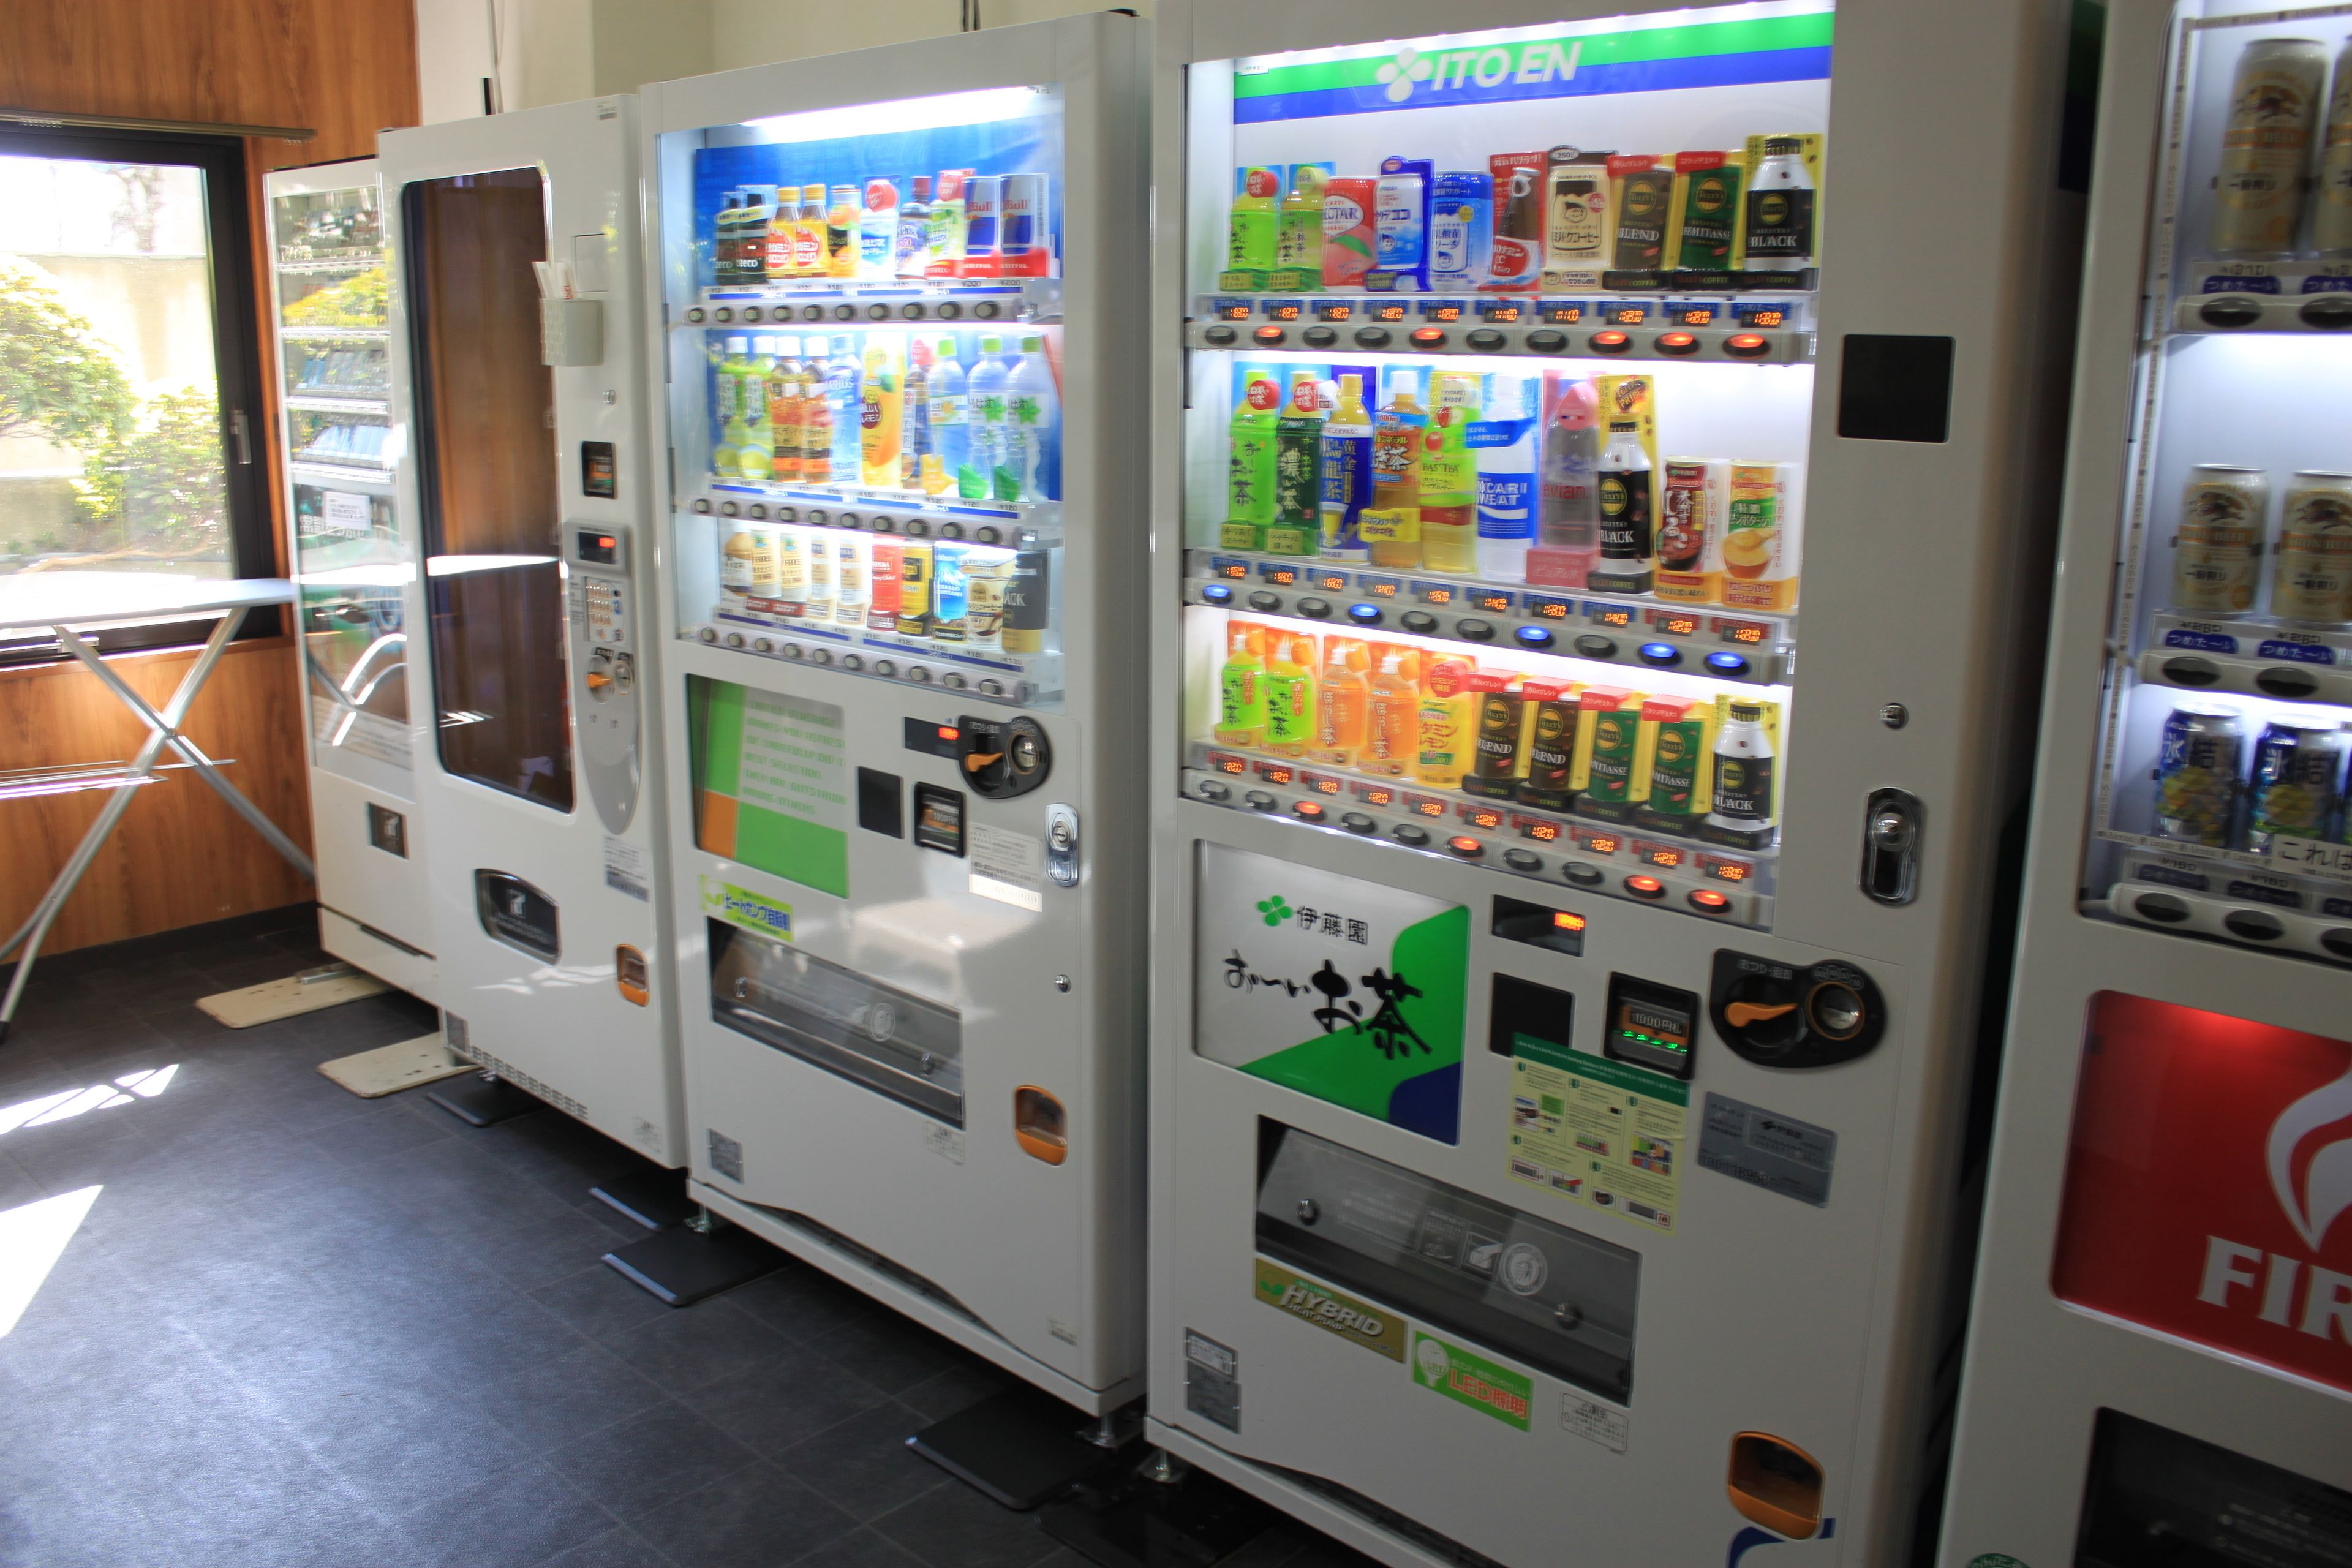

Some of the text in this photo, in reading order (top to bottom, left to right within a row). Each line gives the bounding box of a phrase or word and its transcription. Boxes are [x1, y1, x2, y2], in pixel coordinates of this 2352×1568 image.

[1430, 41, 1583, 91] ITO EN
[1749, 235, 1798, 247] BLACK
[1598, 530, 1635, 543] BLACK
[1476, 737, 1513, 754] BLEND
[1530, 747, 1567, 764] BLEND
[1713, 794, 1754, 810] BLACK
[1296, 905, 1370, 946] 伊藤園
[1279, 1284, 1385, 1336] HYBRID
[1287, 1302, 1346, 1331] HEAT PUMP
